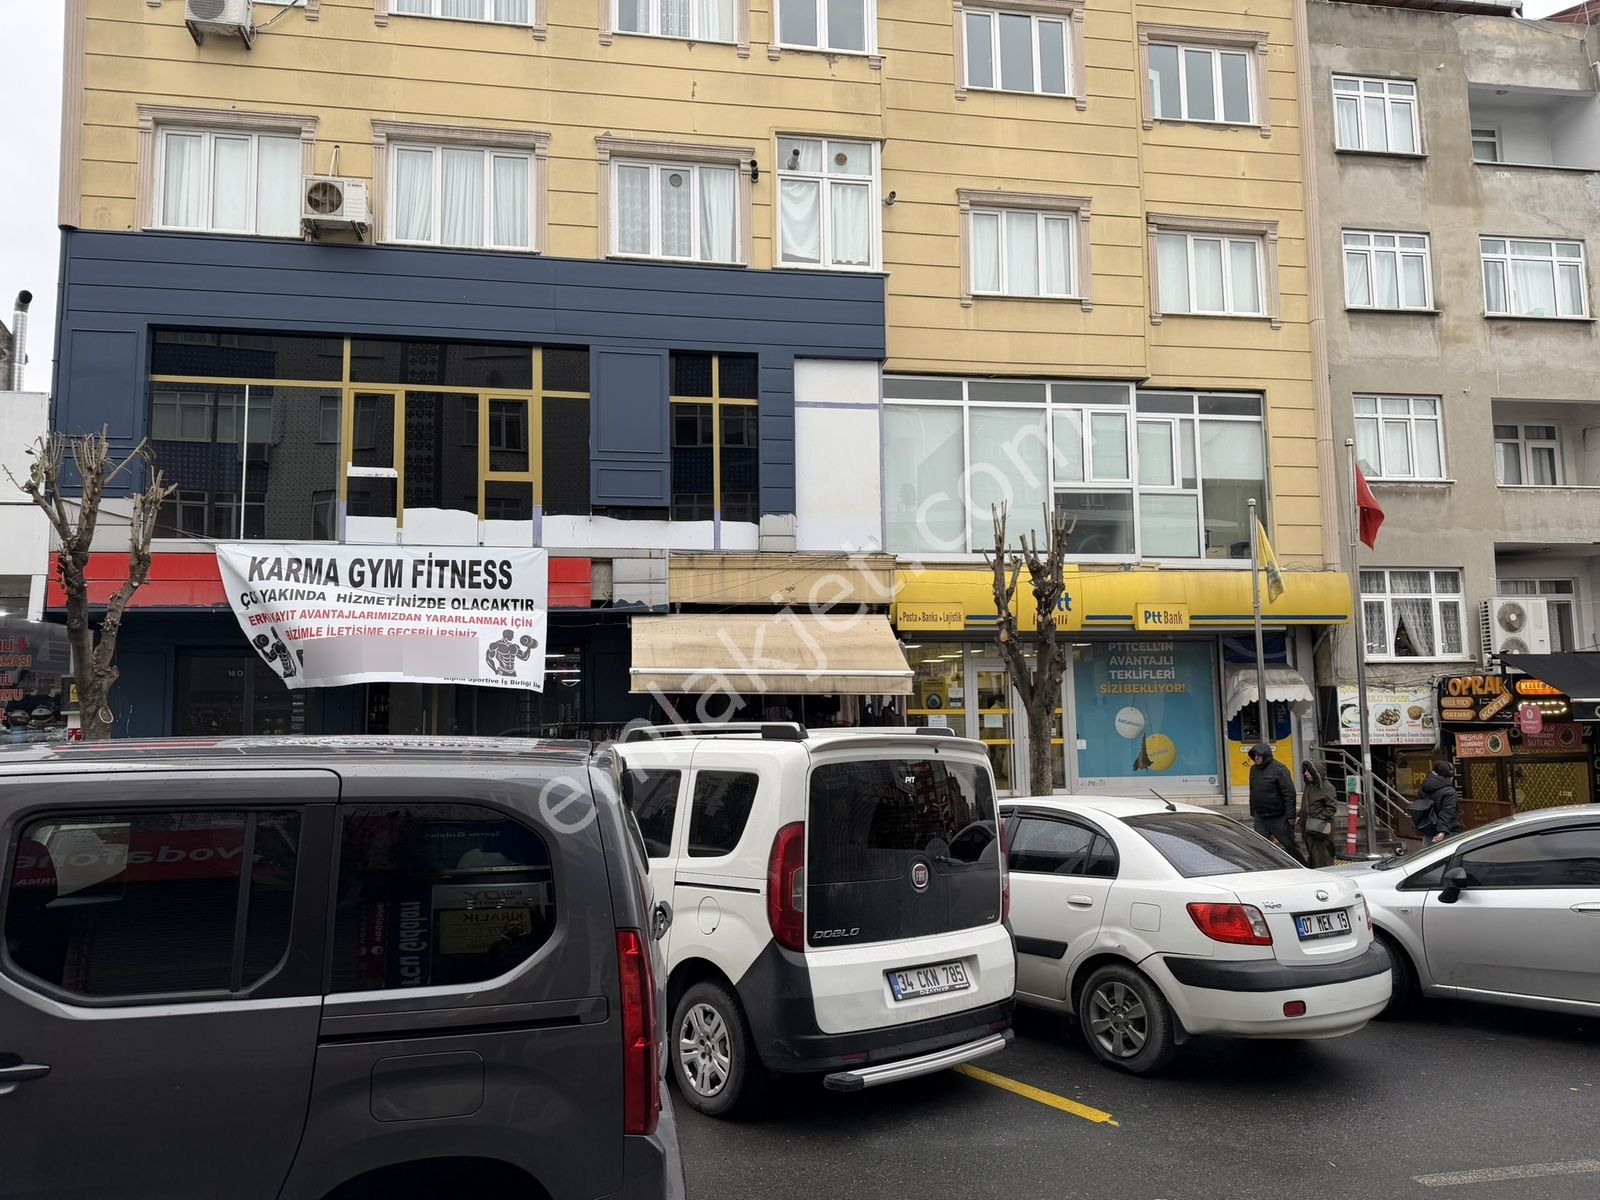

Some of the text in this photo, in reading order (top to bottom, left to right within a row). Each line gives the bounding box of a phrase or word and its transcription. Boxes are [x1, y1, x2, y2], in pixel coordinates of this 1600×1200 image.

[248, 552, 513, 590] KARMA GYM FİTNESS
[260, 588, 327, 603] YAKINDA
[336, 592, 446, 610] HİZMETİNİZDE
[451, 597, 535, 611] OLACAKTIR
[300, 609, 422, 621] AVANTAJLARIMIZDAN
[426, 614, 507, 626] YARARLANMAK
[511, 615, 533, 629] İÇİN
[902, 611, 918, 623] Posta
[922, 611, 938, 623] Banka
[286, 627, 323, 641] BİZİMLE
[1109, 656, 1174, 666] AVANTAJLI
[1109, 667, 1176, 680] TEKLİFLERİ
[1100, 682, 1122, 694] SİZİ
[1301, 917, 1313, 933] 07
[1336, 911, 1348, 928] 15
[813, 927, 861, 940] DOBLO
[897, 964, 965, 991] 34 CKN 785
